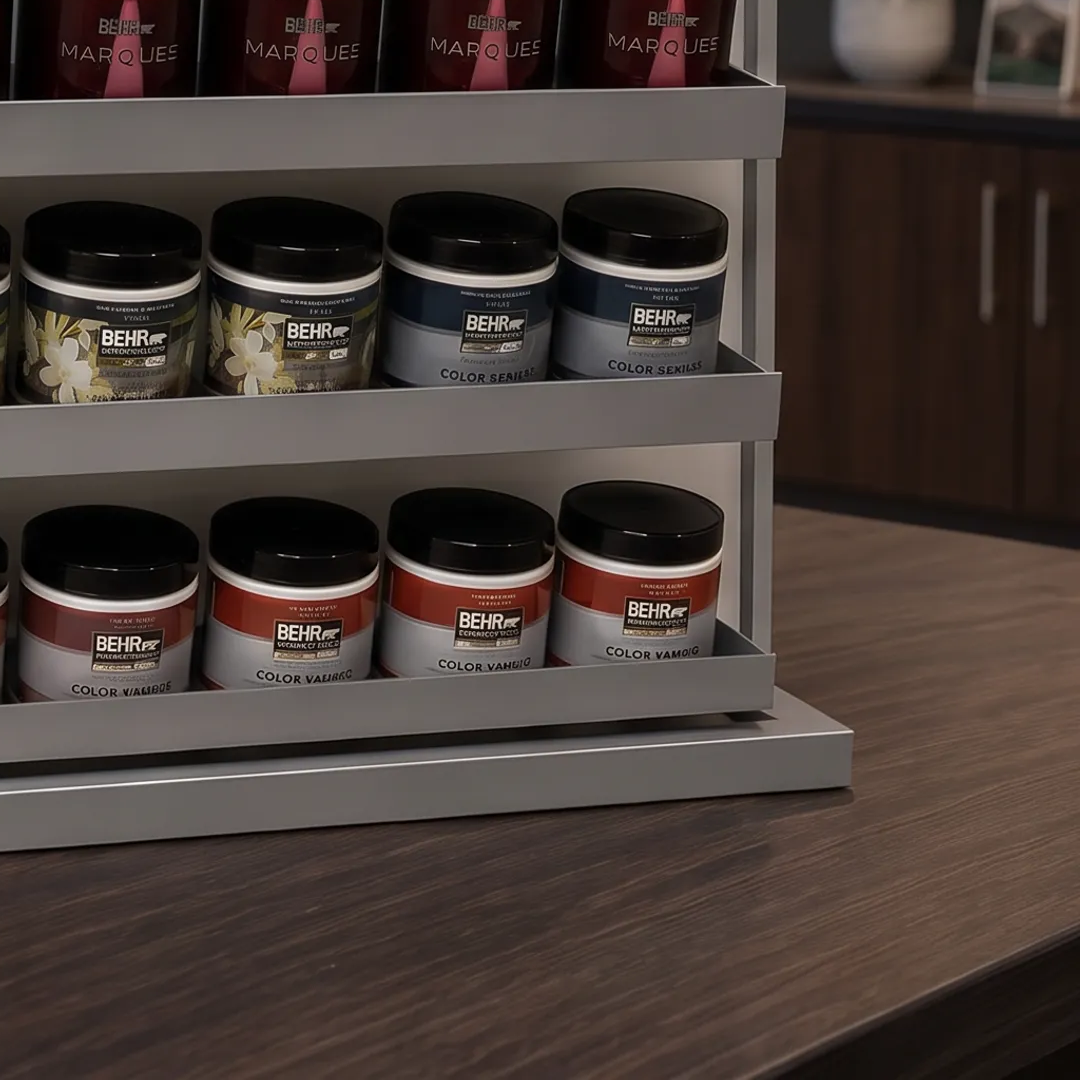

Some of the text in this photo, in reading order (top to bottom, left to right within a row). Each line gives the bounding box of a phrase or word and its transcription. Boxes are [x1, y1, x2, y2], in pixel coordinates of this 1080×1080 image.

[466, 314, 510, 332] BEHR
[633, 307, 677, 326] BEHR
[101, 329, 149, 347] BEHR
[287, 322, 333, 340] BEHR
[440, 368, 485, 383] COLOR
[608, 359, 653, 375] COLOR
[627, 601, 671, 619] BEHR
[459, 611, 504, 630] BEHR
[277, 623, 322, 641] BEHR
[96, 635, 142, 652] BEHR
[605, 646, 651, 660] COLOR
[438, 659, 483, 672] COLOR
[256, 670, 301, 684] COLOR
[71, 684, 118, 697] COLOR
